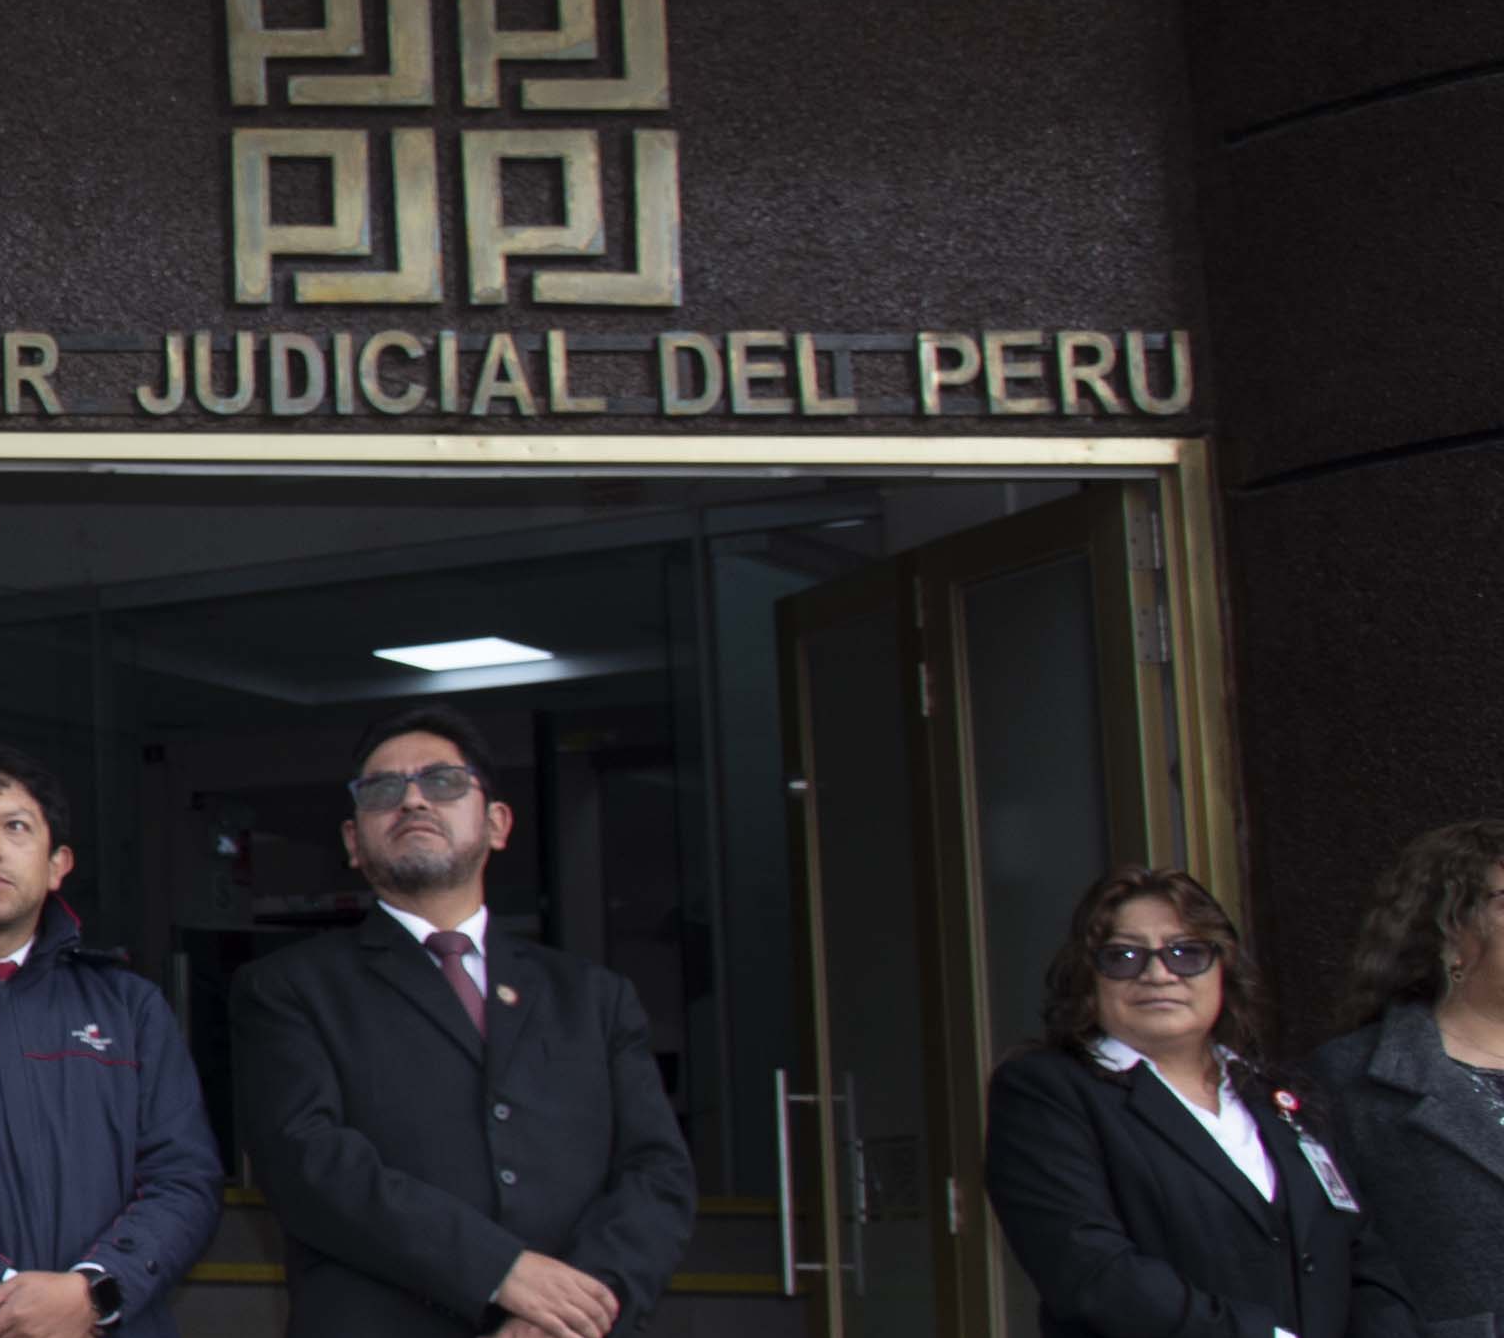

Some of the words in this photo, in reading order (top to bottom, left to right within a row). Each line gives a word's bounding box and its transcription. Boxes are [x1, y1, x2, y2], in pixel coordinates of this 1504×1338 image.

[135, 329, 608, 416] JUDICIAL
[657, 330, 858, 416] DEL
[918, 330, 1189, 416] PERU
